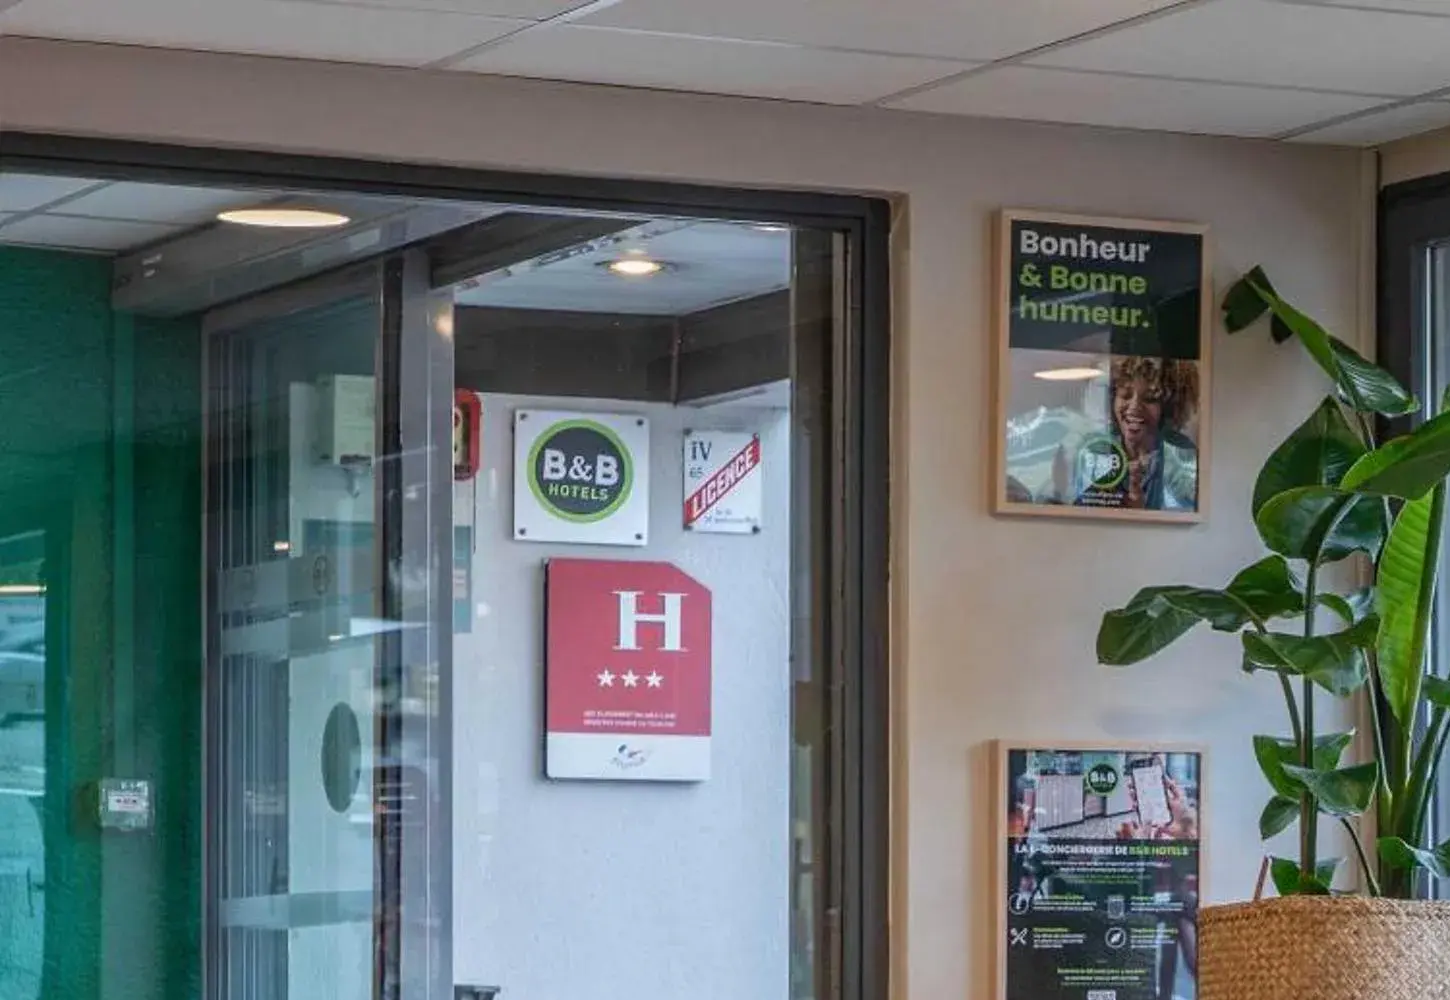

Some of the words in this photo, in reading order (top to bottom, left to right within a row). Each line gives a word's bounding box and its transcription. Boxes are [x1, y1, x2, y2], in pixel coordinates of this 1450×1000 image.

[1020, 229, 1150, 262] Bonheur
[1020, 263, 1041, 288] &
[1050, 265, 1147, 295] Bonne
[1020, 294, 1149, 328] humeur.
[543, 448, 619, 486] B&B
[692, 444, 754, 519] LICENCE
[548, 484, 608, 501] HOTELS
[612, 591, 689, 652] H
